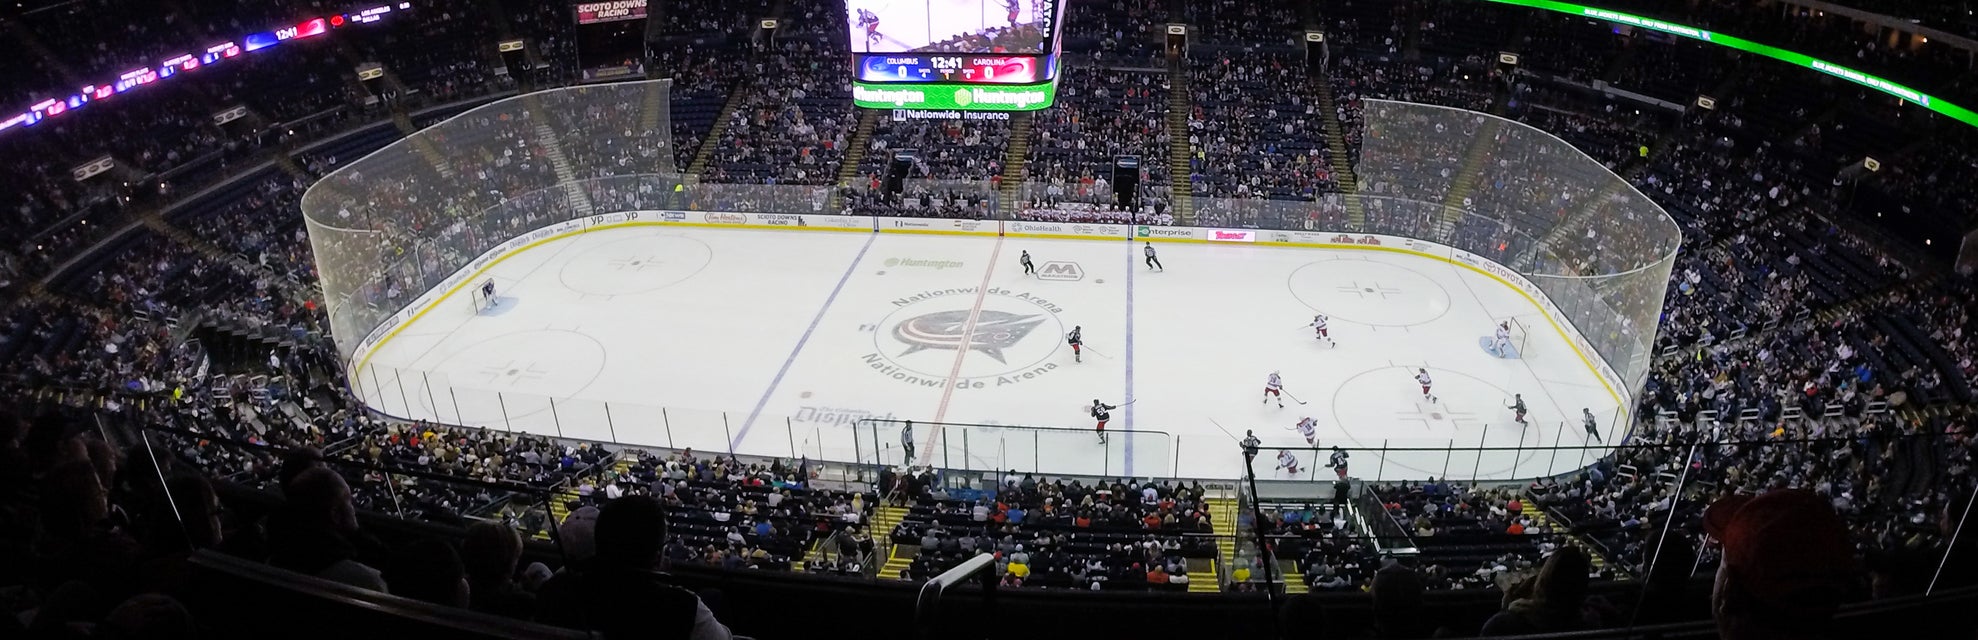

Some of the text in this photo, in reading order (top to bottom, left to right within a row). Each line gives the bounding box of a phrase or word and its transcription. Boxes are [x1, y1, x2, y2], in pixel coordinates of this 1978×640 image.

[578, 0, 648, 13] SCIOTO DOWNS
[597, 8, 629, 18] RACINO
[276, 26, 298, 40] 12:41
[886, 56, 1006, 69] COLUMBUS 12:41 CAROLINA
[897, 65, 907, 79] 0
[984, 66, 994, 79] 0
[853, 86, 925, 106] Huntington
[973, 88, 1045, 107] Huntington
[906, 109, 1010, 120] Nationwide Insurance
[591, 215, 604, 225] yp
[625, 211, 638, 222] yp
[899, 258, 964, 270] Huntington
[1044, 263, 1077, 275] M
[1496, 267, 1523, 287] TOYOTA
[1015, 291, 1064, 314] Arena
[996, 361, 1059, 387] Arena
